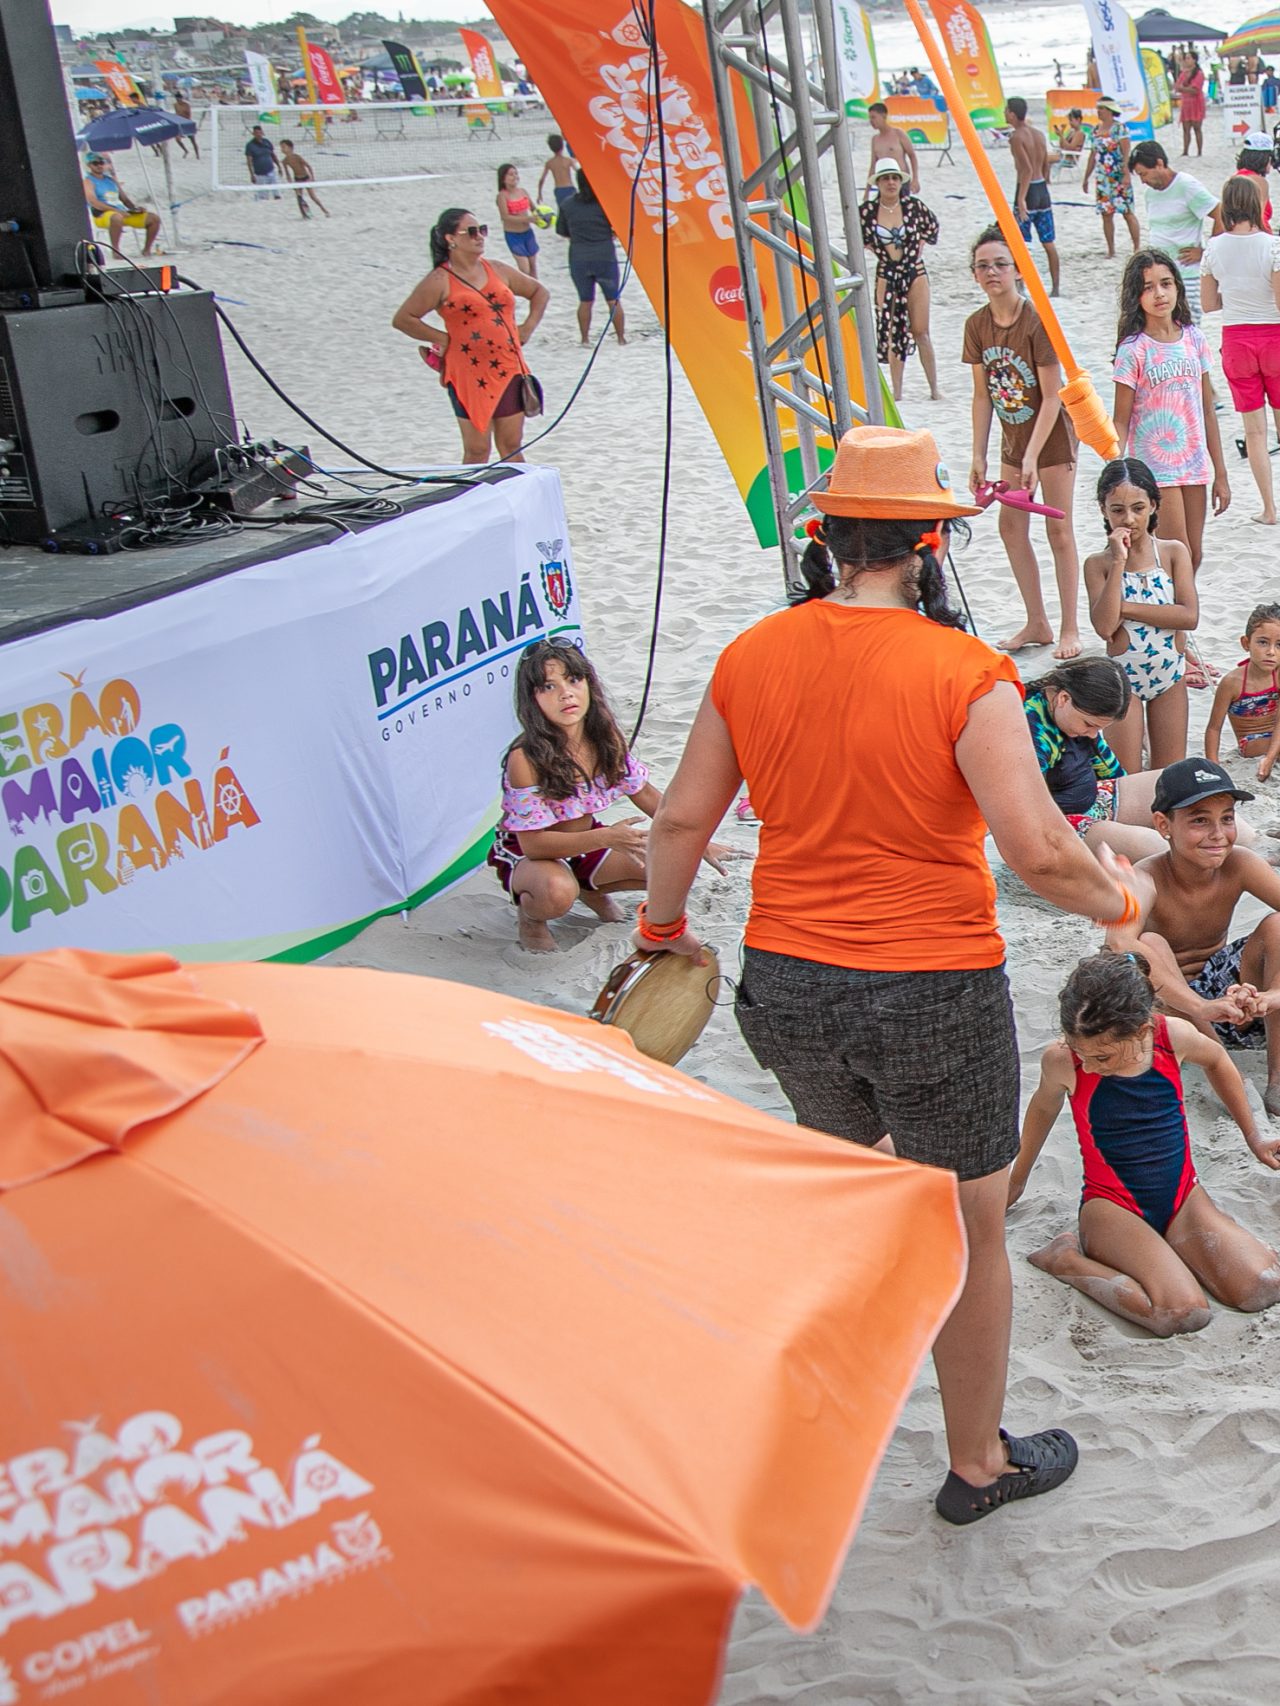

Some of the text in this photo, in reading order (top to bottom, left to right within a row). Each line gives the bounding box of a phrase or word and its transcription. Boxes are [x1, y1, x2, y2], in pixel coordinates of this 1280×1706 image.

[368, 571, 544, 709] PARANÁ
[0, 667, 141, 778] ERÃO
[381, 664, 510, 742] GOVERNO DO
[1, 723, 192, 837] MAIOR
[0, 745, 262, 934] ARANÁ
[0, 1433, 374, 1638] ARANÁ
[24, 1620, 152, 1682] COPEL
